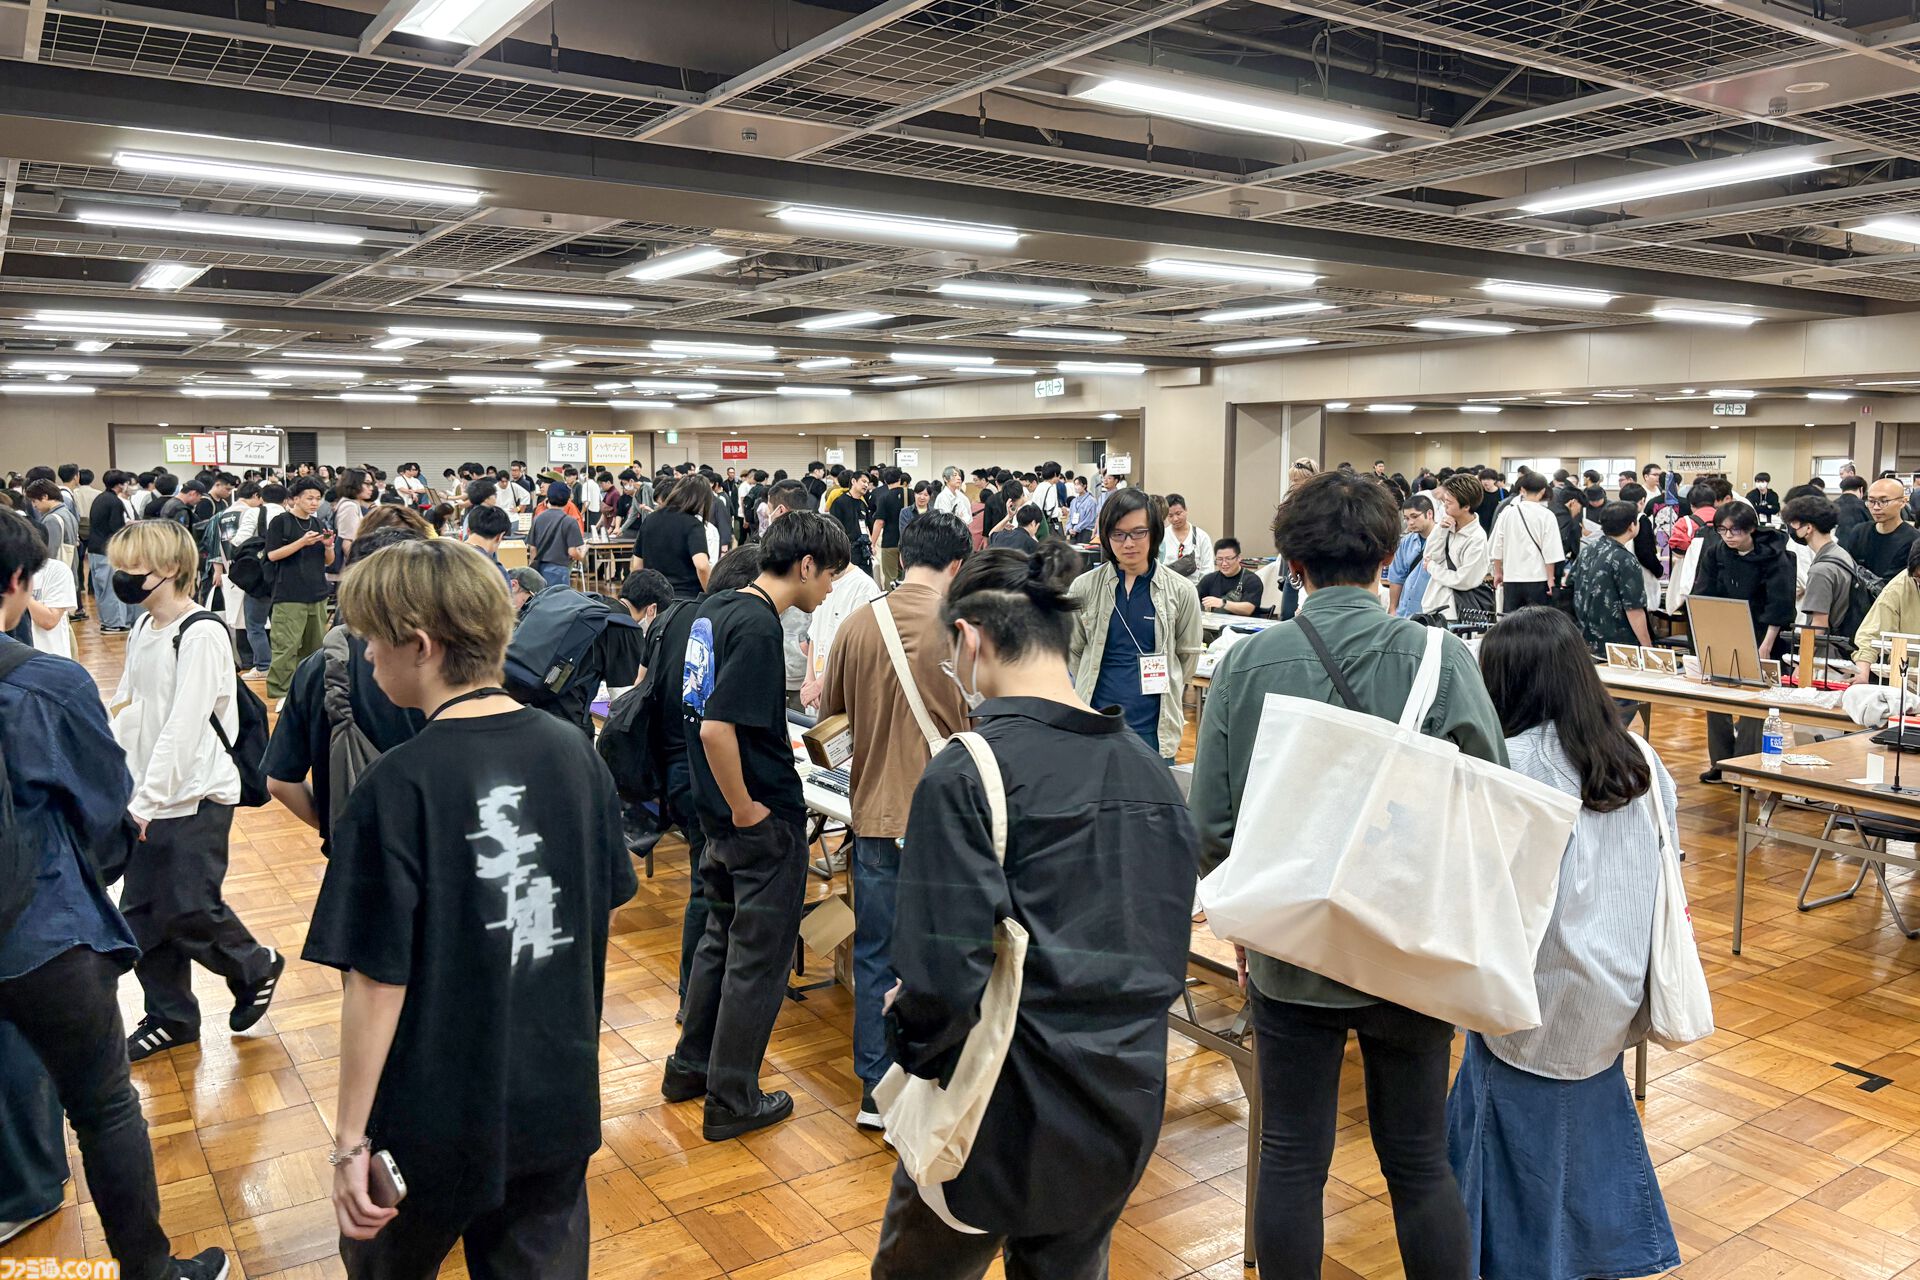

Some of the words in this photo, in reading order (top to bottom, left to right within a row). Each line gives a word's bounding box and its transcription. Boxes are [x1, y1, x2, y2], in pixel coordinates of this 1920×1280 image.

[234, 441, 275, 452] ライデン
[558, 442, 579, 452] キ83
[724, 445, 747, 454] 最後尾
